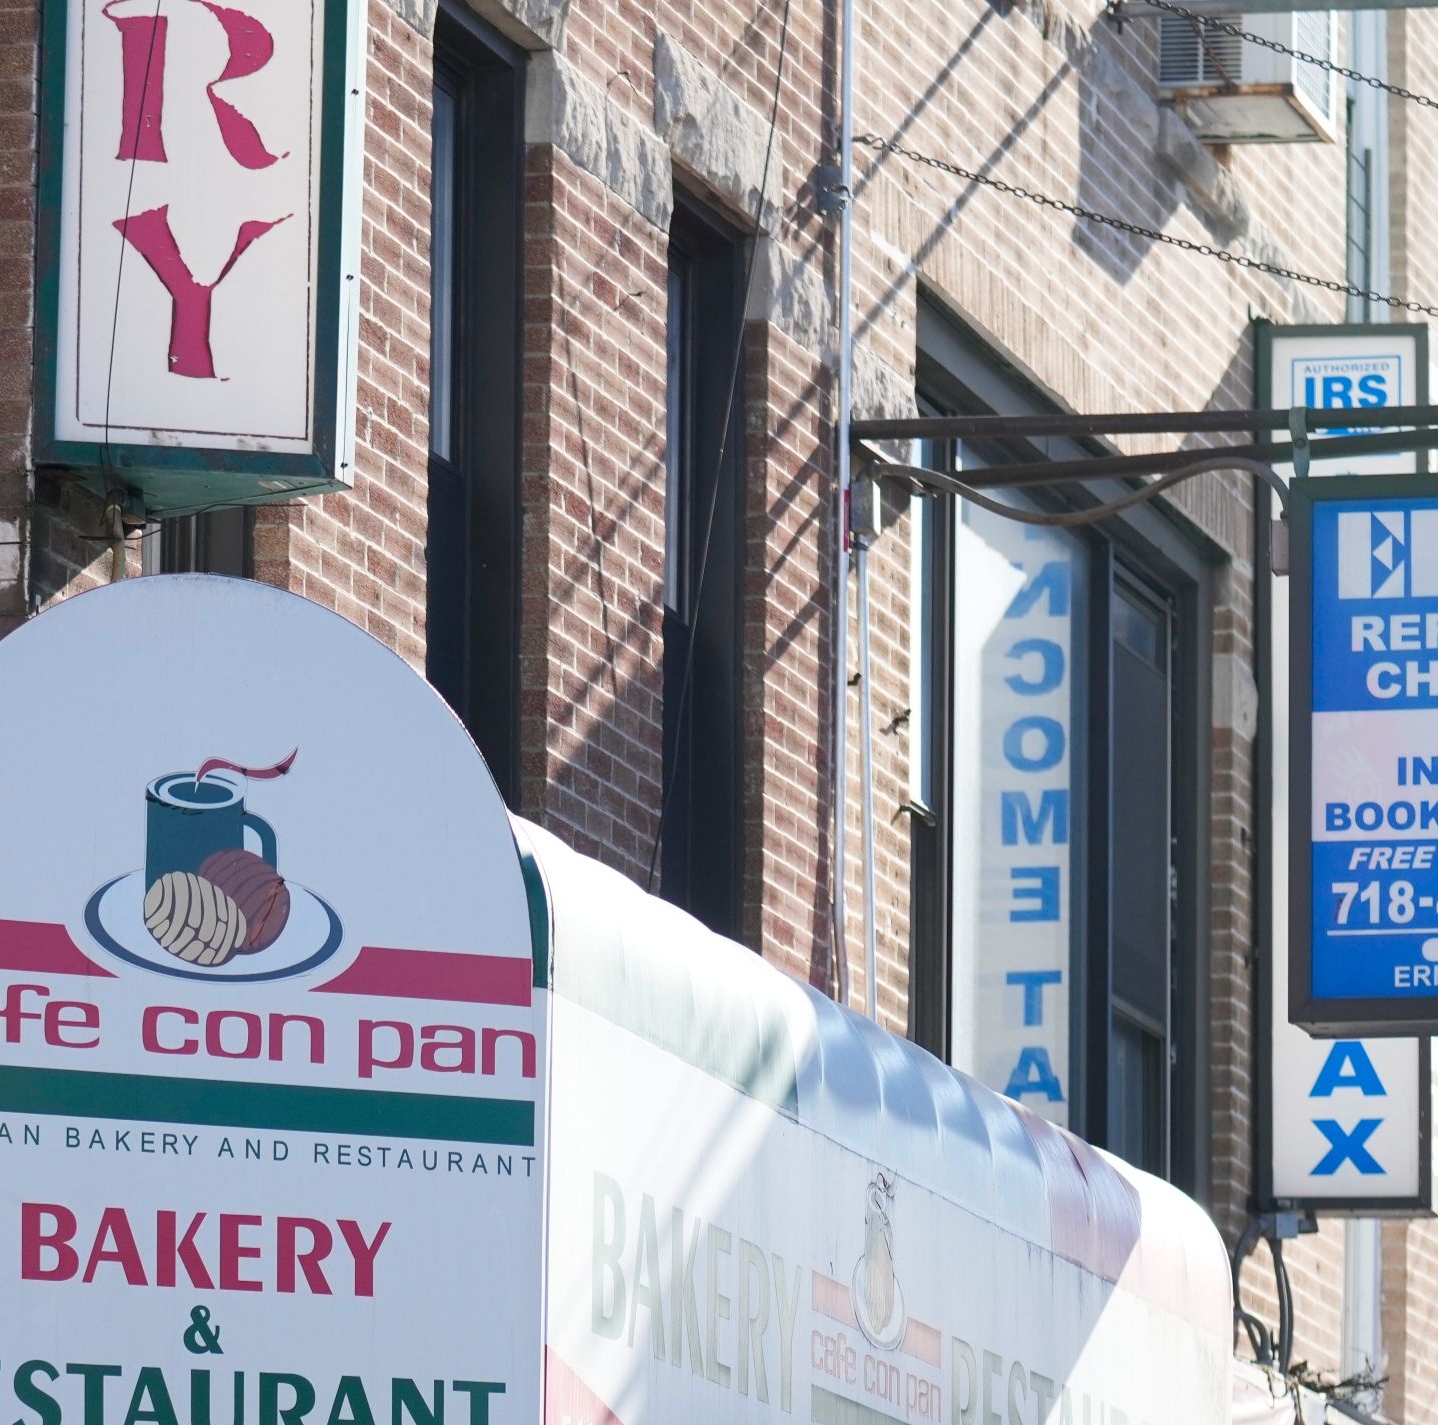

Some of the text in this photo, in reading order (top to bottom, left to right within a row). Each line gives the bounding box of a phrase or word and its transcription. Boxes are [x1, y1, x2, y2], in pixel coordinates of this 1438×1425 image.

[1304, 362, 1390, 373] AUTHORIZED
[1305, 375, 1387, 409] IRS
[1349, 845, 1436, 871] FREE
[142, 1006, 325, 1065] con
[358, 1019, 537, 1079] pan
[1309, 1040, 1386, 1176] AX
[66, 1127, 199, 1156] BAKERY
[218, 1137, 289, 1162] AND
[313, 1143, 536, 1178] RESTAURANT
[21, 1202, 392, 1297] BAKERY
[591, 1170, 803, 1415] BAKERY
[810, 1328, 942, 1423] cafe con pan
